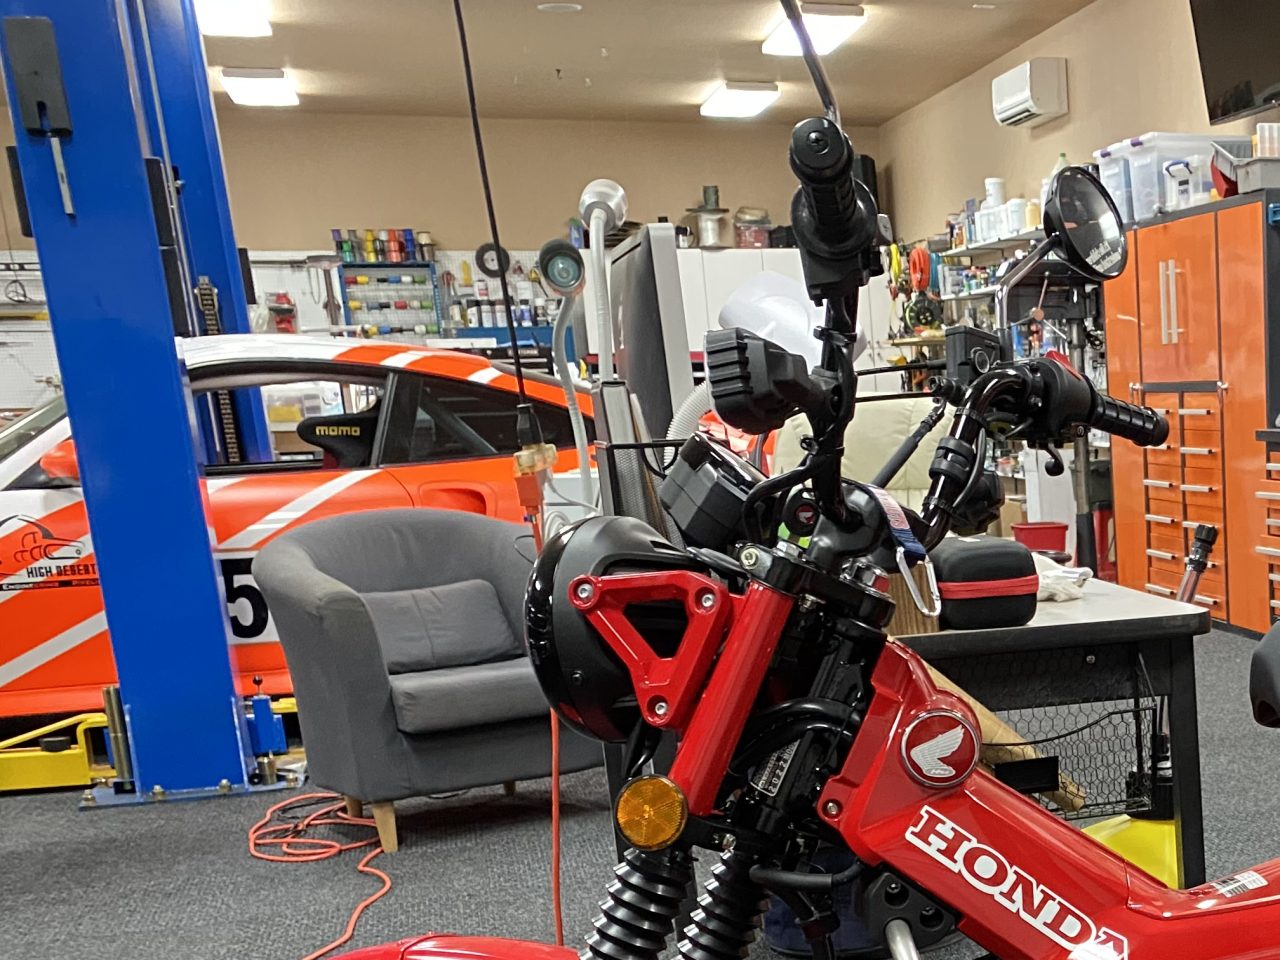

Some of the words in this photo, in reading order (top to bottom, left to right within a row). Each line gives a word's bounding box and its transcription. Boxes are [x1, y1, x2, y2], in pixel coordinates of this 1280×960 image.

[315, 425, 361, 436] momo
[26, 565, 53, 579] HIGH
[220, 557, 269, 639] 5
